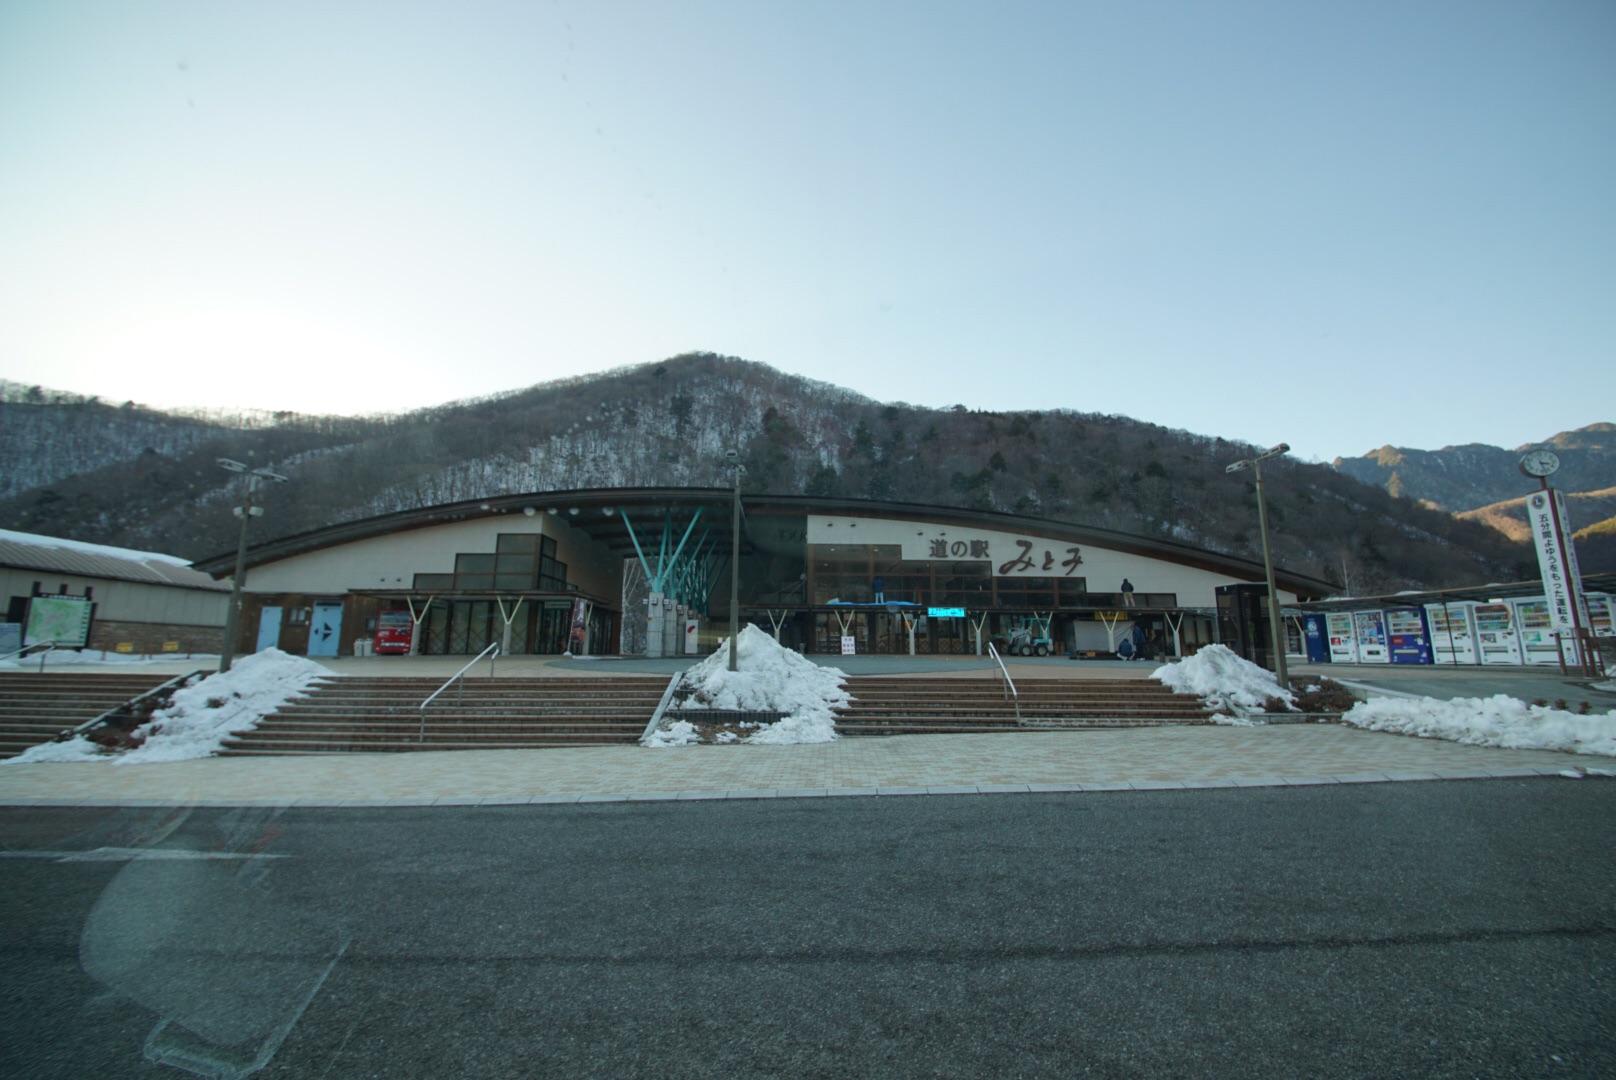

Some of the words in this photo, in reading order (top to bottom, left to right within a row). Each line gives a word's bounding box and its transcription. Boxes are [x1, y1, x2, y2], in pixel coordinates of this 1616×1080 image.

[929, 538, 990, 559] 道の駅
[998, 539, 1084, 576] みとみ
